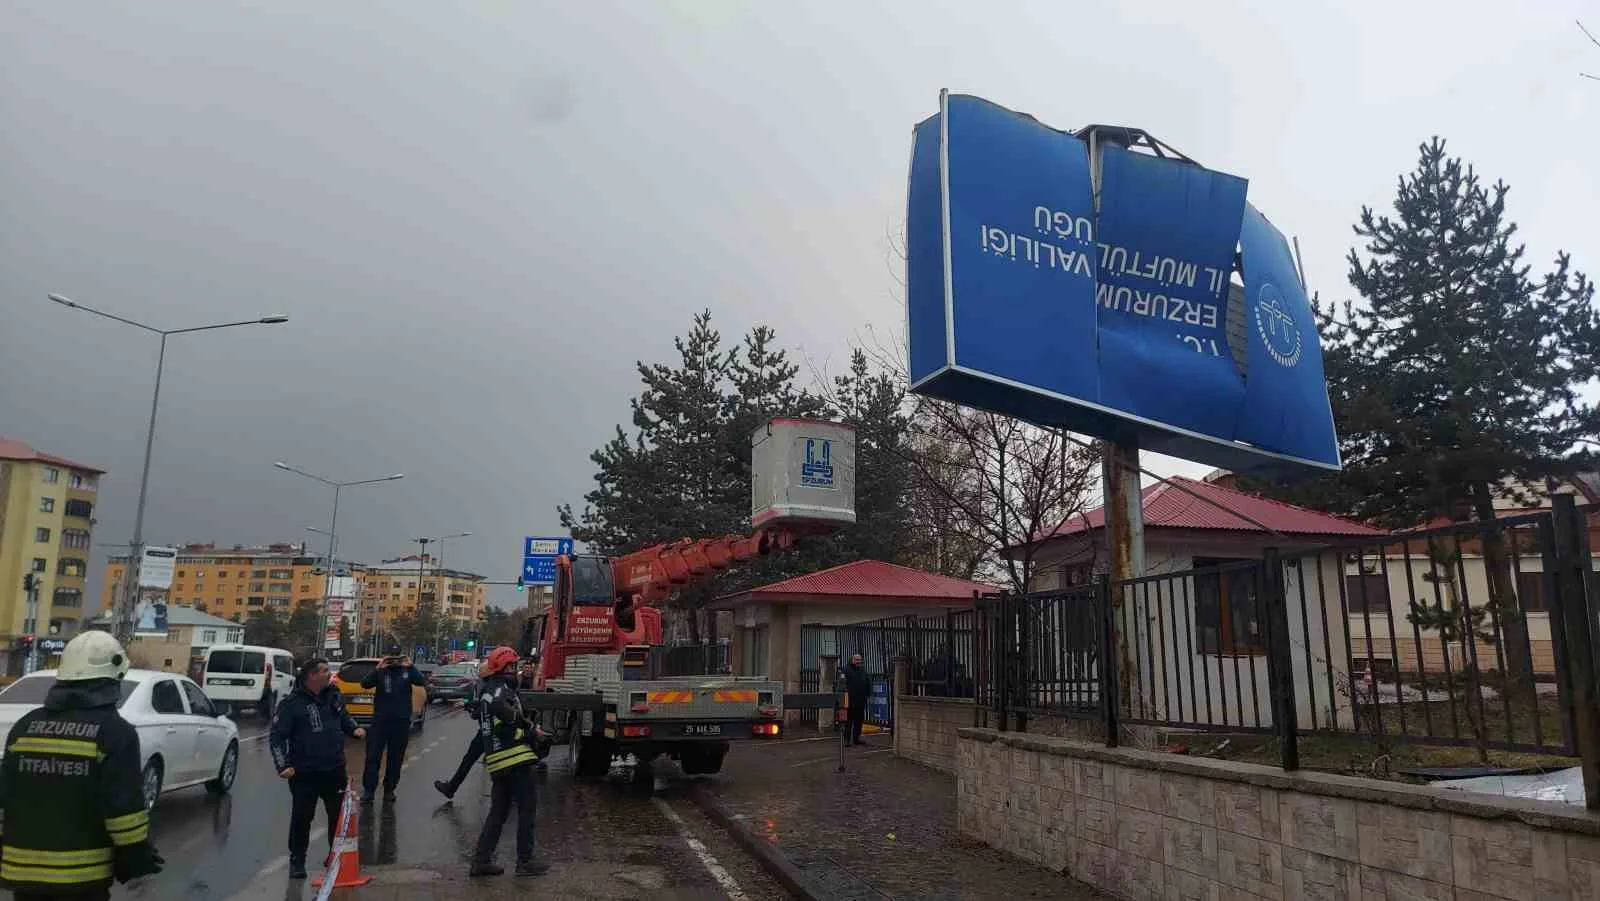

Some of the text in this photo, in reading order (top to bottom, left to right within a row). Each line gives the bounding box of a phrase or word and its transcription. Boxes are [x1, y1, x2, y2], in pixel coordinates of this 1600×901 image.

[981, 224, 1217, 328] ERZURUM VALİLİĞİ
[1205, 267, 1225, 298] İL
[576, 617, 609, 625] ERZURUM
[26, 720, 100, 737] ERZURUM
[18, 755, 90, 776] İTFAİYESİ
